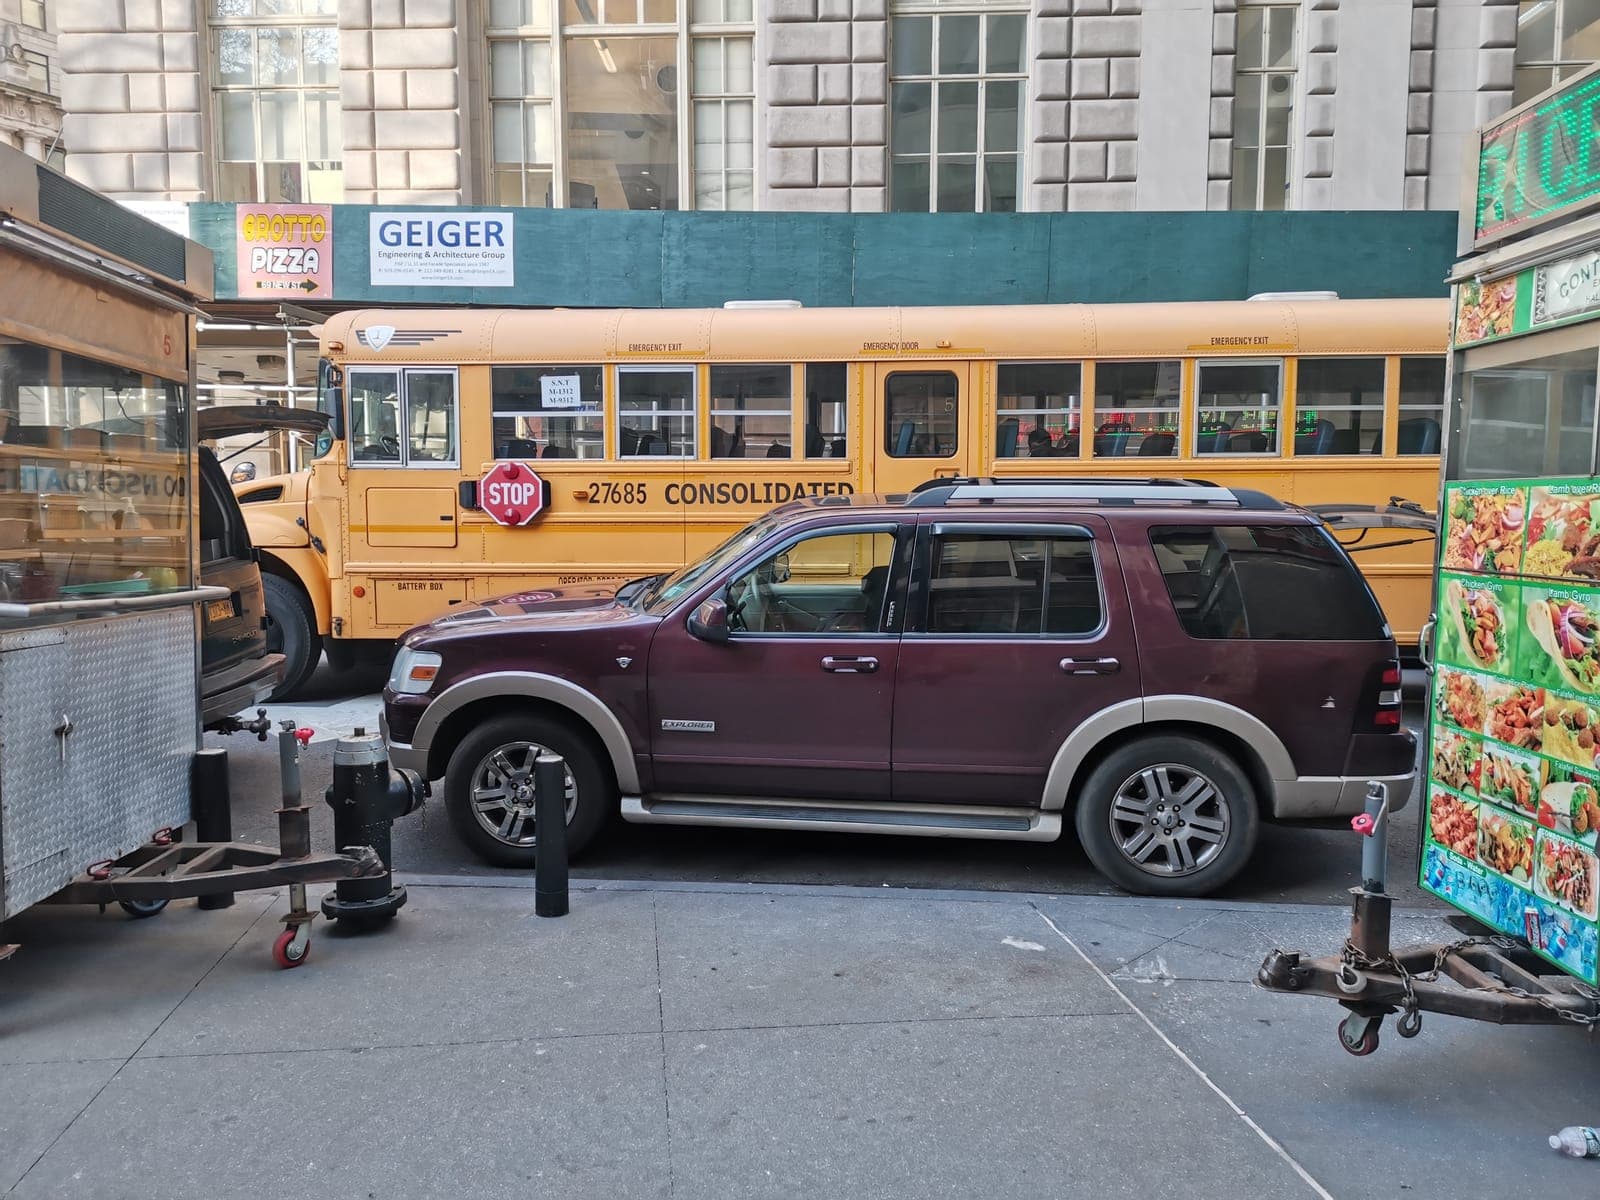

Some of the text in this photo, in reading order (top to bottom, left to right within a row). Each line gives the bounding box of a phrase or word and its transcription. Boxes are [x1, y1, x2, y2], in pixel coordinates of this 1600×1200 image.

[243, 213, 326, 242] GROTTO
[379, 220, 505, 247] GEIGER
[251, 247, 319, 274] PIZZA
[378, 251, 423, 259] Engineering
[433, 251, 480, 259] Architecture
[481, 251, 506, 259] Group
[163, 334, 171, 356] 5
[863, 342, 919, 351] EMERGENCY DOOR
[1211, 336, 1269, 345] EMERGENCY EXIT
[628, 343, 682, 352] EMERGENCY EXIT
[489, 483, 535, 505] STOP
[588, 482, 854, 505] 27685 CONSOLIDATED
[1500, 485, 1516, 495] Rice
[1548, 484, 1569, 494] Lamb
[397, 582, 443, 591] BATTERY BOX
[1460, 578, 1503, 592] Chicken Gyro
[1548, 588, 1591, 602] Lamb Gyro
[663, 720, 714, 729] EXPLORER
